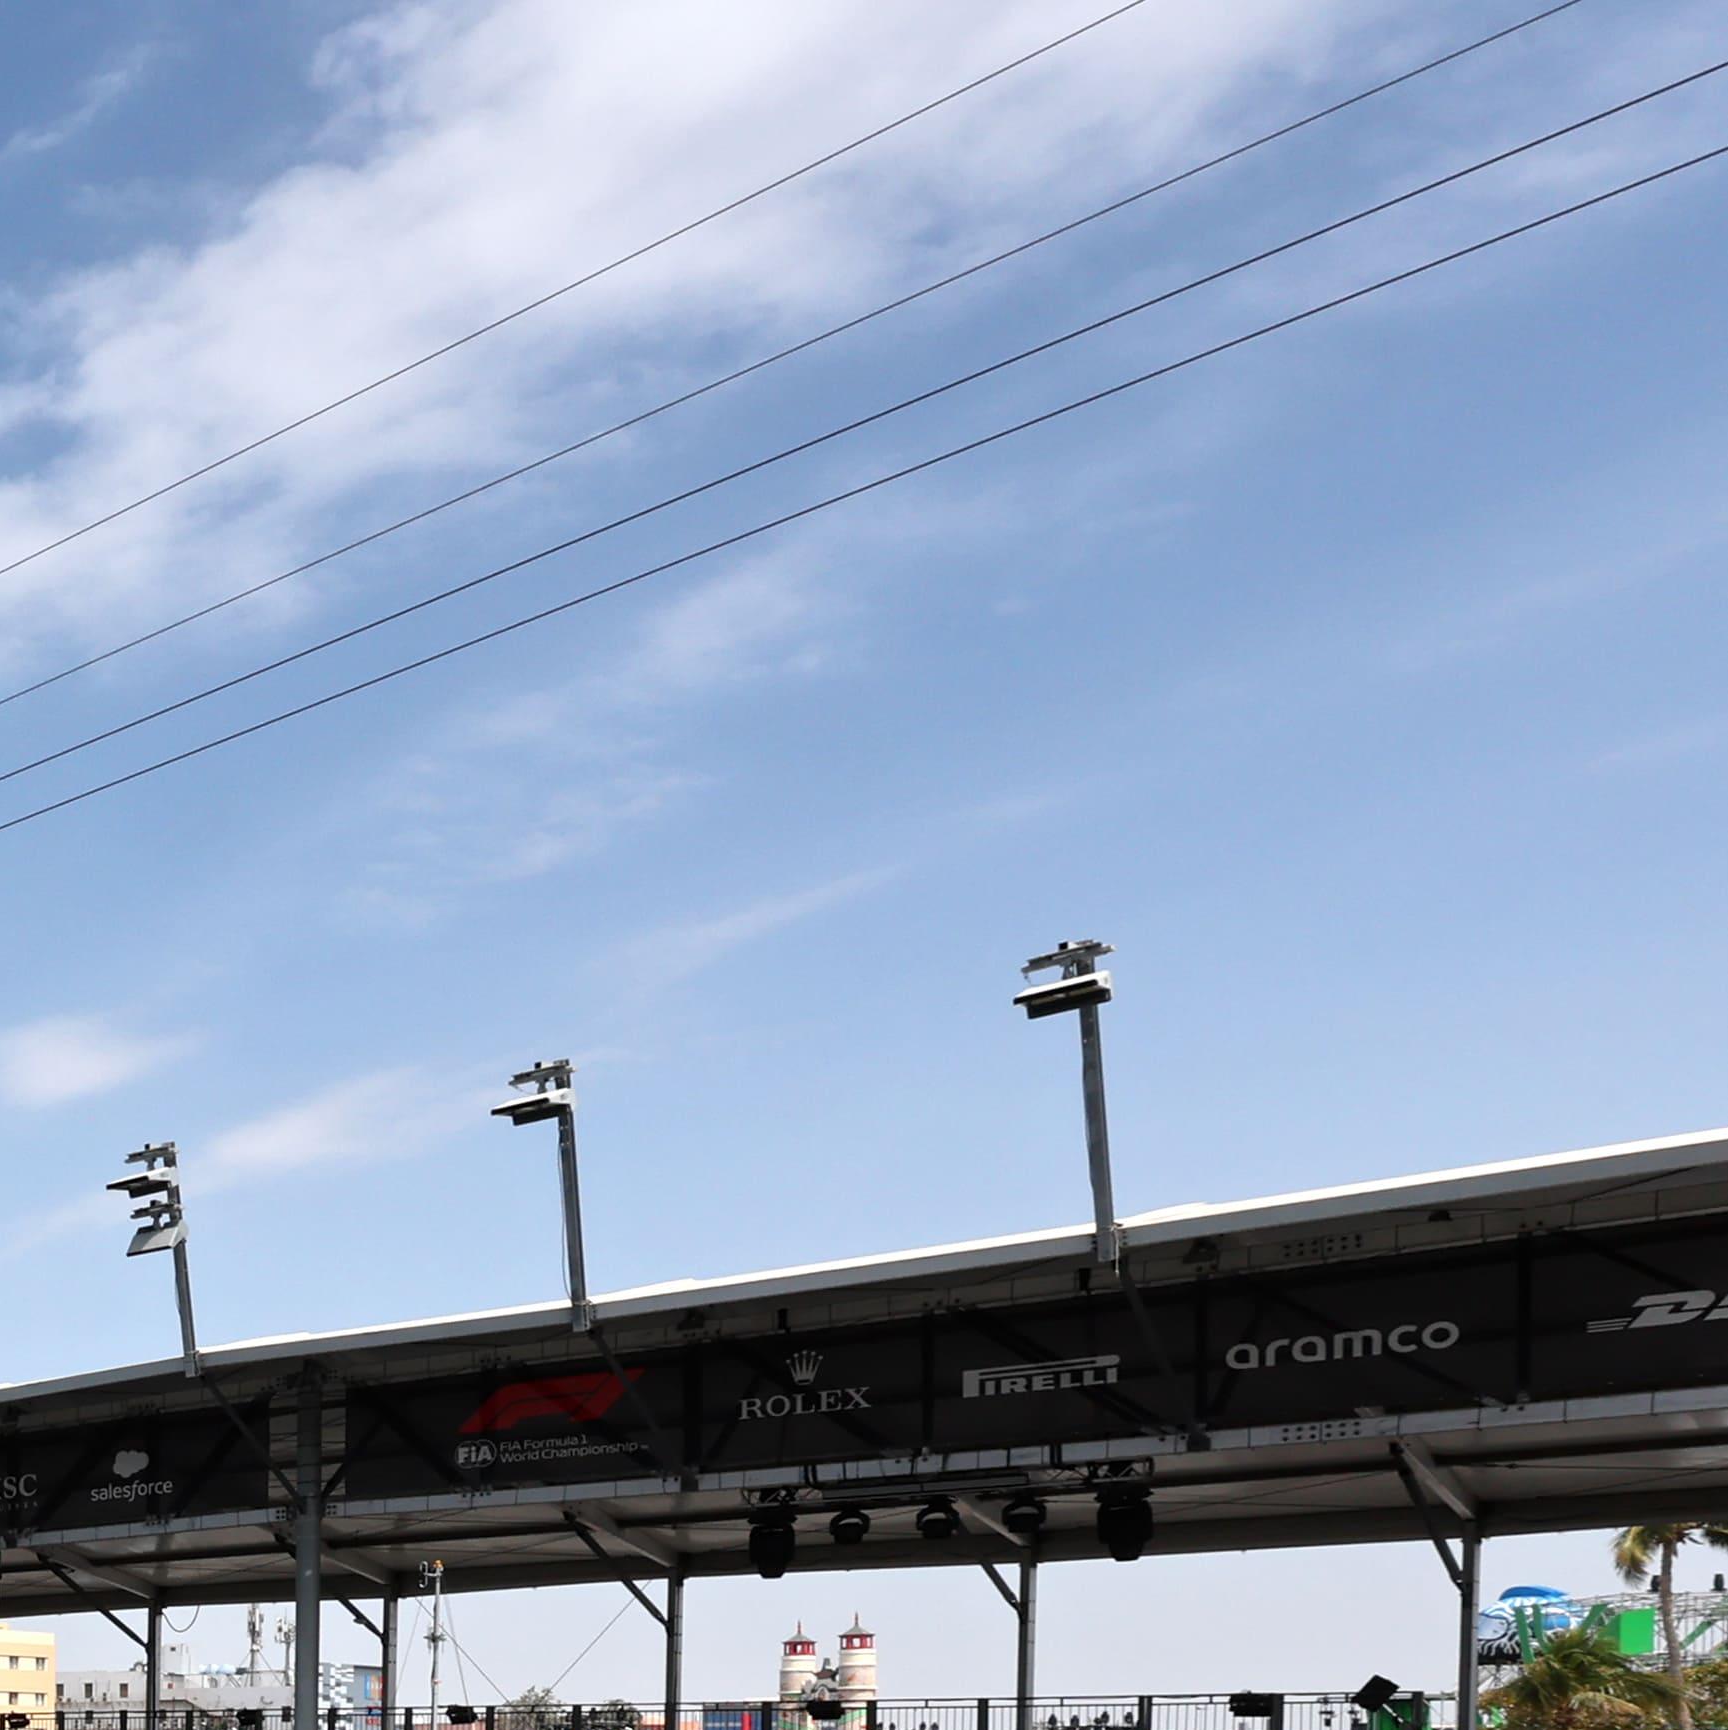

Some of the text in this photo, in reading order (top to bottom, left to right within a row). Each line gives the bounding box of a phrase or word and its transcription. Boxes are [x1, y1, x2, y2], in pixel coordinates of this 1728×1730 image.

[1226, 1320, 1460, 1369] aramco
[963, 1355, 1120, 1398] PIRELLI
[738, 1386, 870, 1420] ROLEX
[500, 1440, 521, 1451] FIA
[524, 1436, 579, 1450] Formula
[500, 1442, 638, 1463] World Championship
[91, 1480, 174, 1502] salesforce
